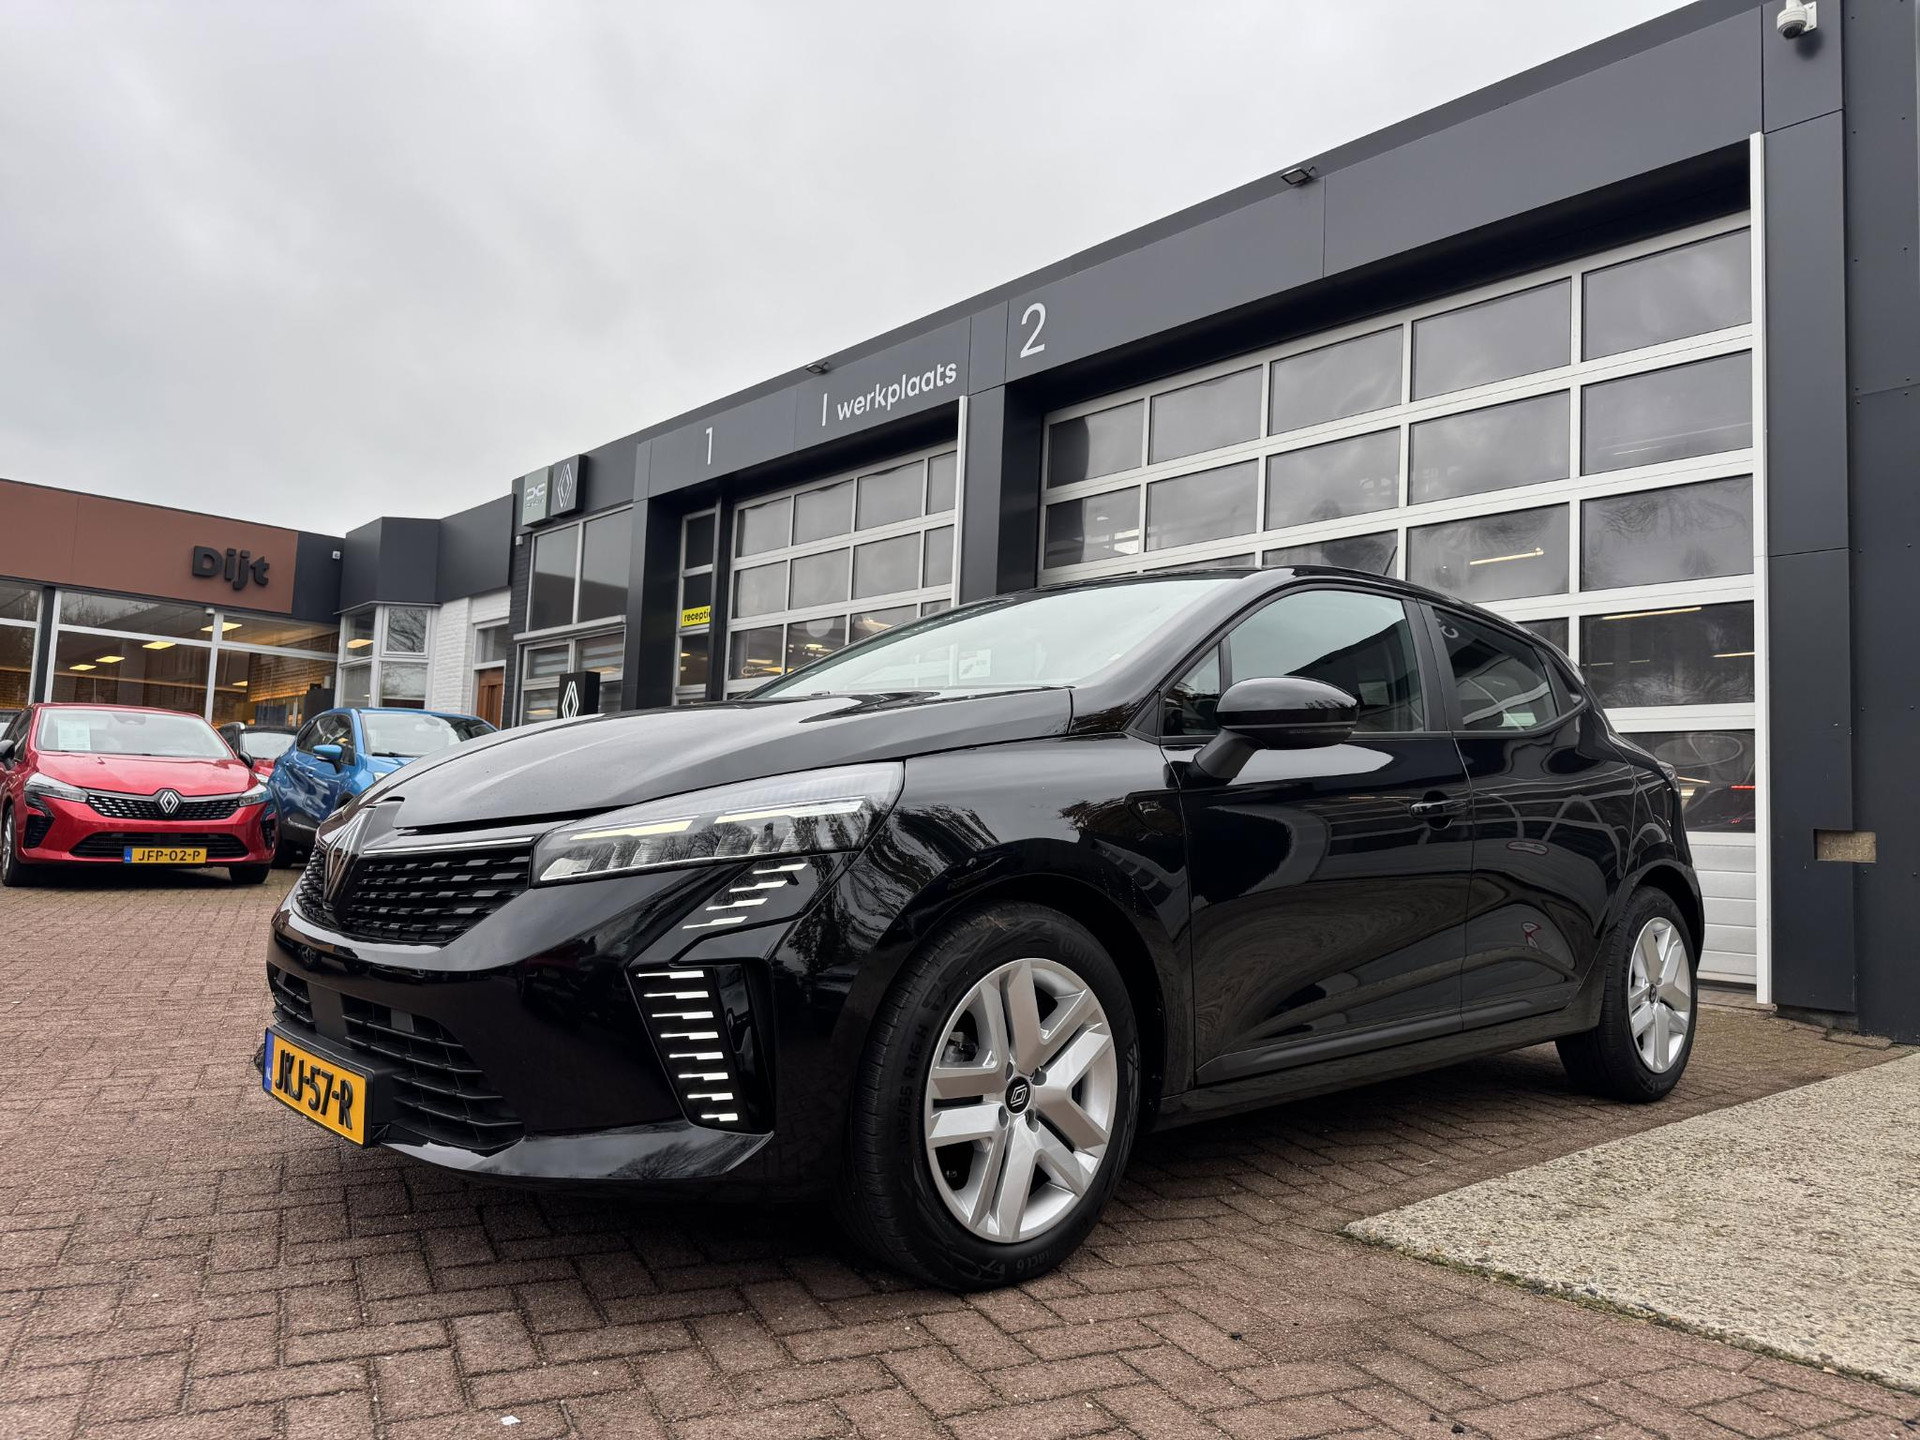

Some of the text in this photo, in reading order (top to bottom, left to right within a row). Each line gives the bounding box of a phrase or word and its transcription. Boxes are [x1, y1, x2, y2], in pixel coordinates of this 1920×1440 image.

[1020, 303, 1046, 358] 2
[837, 363, 957, 420] werkplaats
[705, 427, 713, 465] 1
[192, 545, 270, 591] Dijt
[138, 850, 201, 862] JFP-02-P
[275, 1049, 354, 1131] JKJ-57-R
